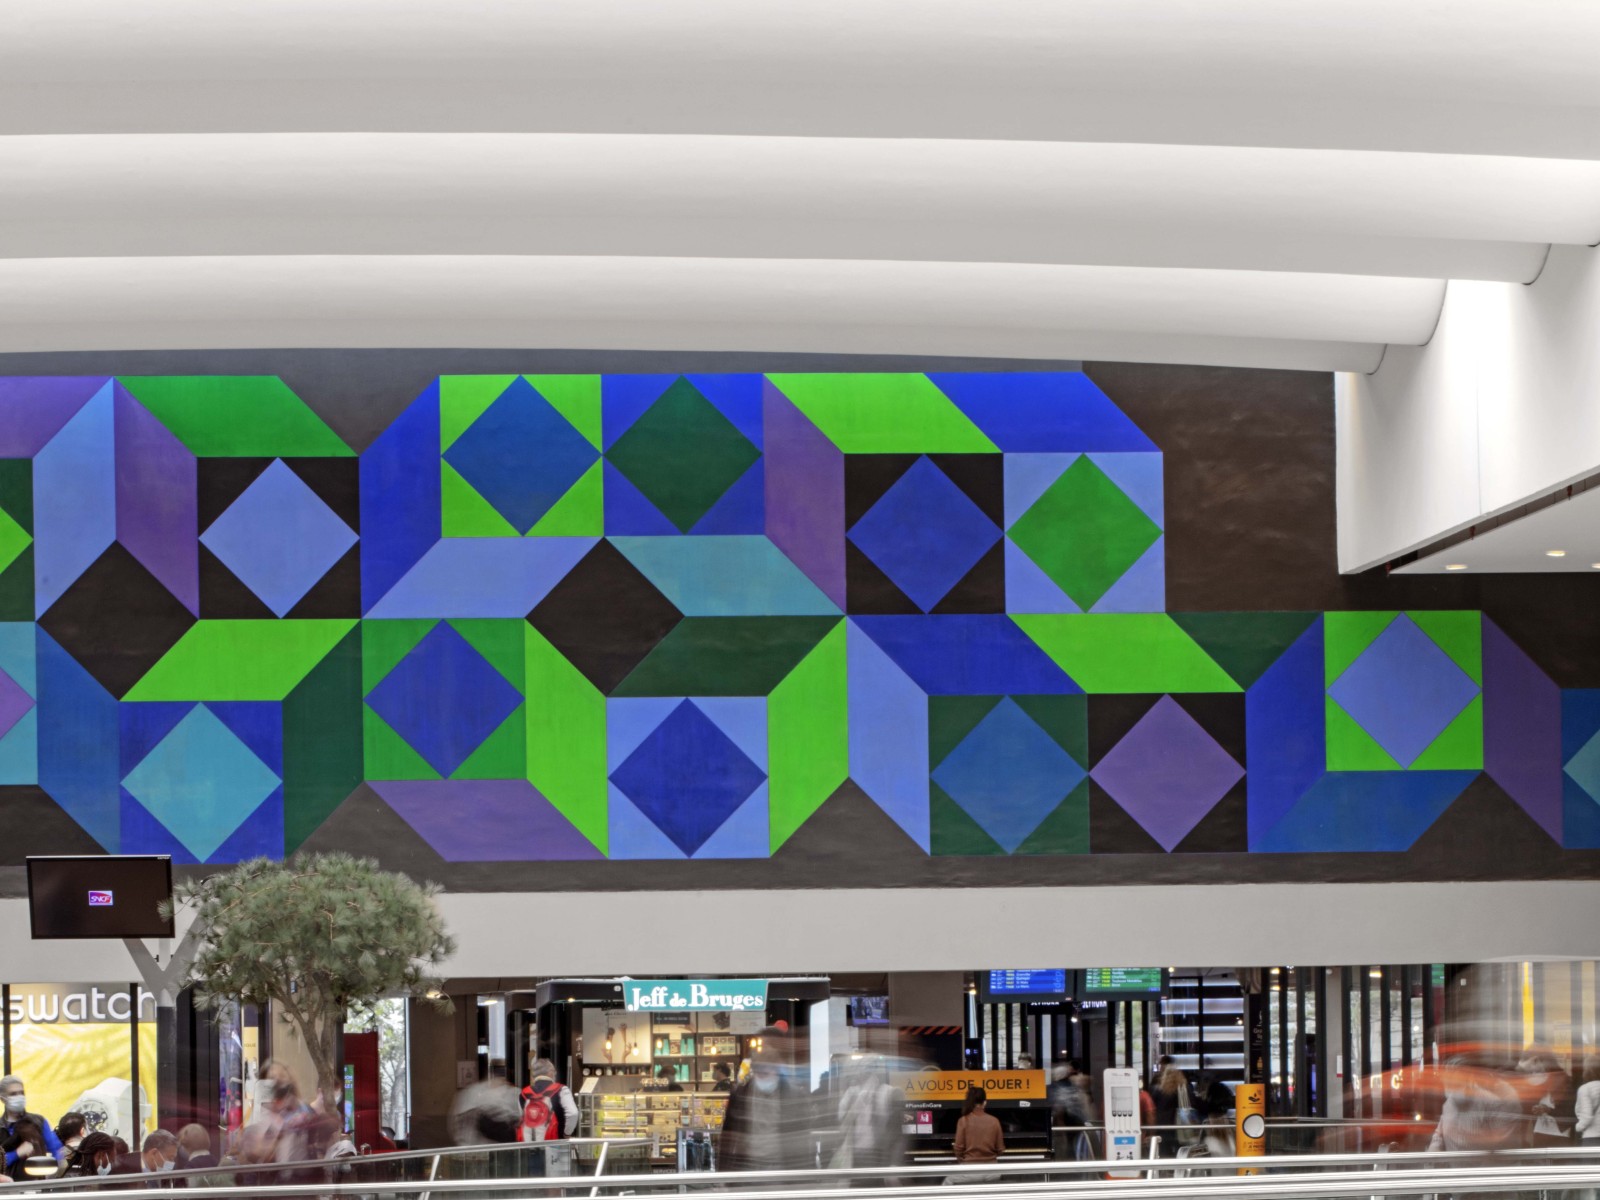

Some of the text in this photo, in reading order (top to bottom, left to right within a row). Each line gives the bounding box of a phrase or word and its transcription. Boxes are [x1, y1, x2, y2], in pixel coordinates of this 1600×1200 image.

[90, 895, 111, 904] SNCF
[0, 987, 157, 1021] swatch
[627, 984, 763, 1011] Jeff de Bruges
[905, 1078, 915, 1091] À
[918, 1079, 953, 1091] VOUS
[957, 1079, 974, 1090] DE
[982, 1079, 1023, 1090] JOUER
